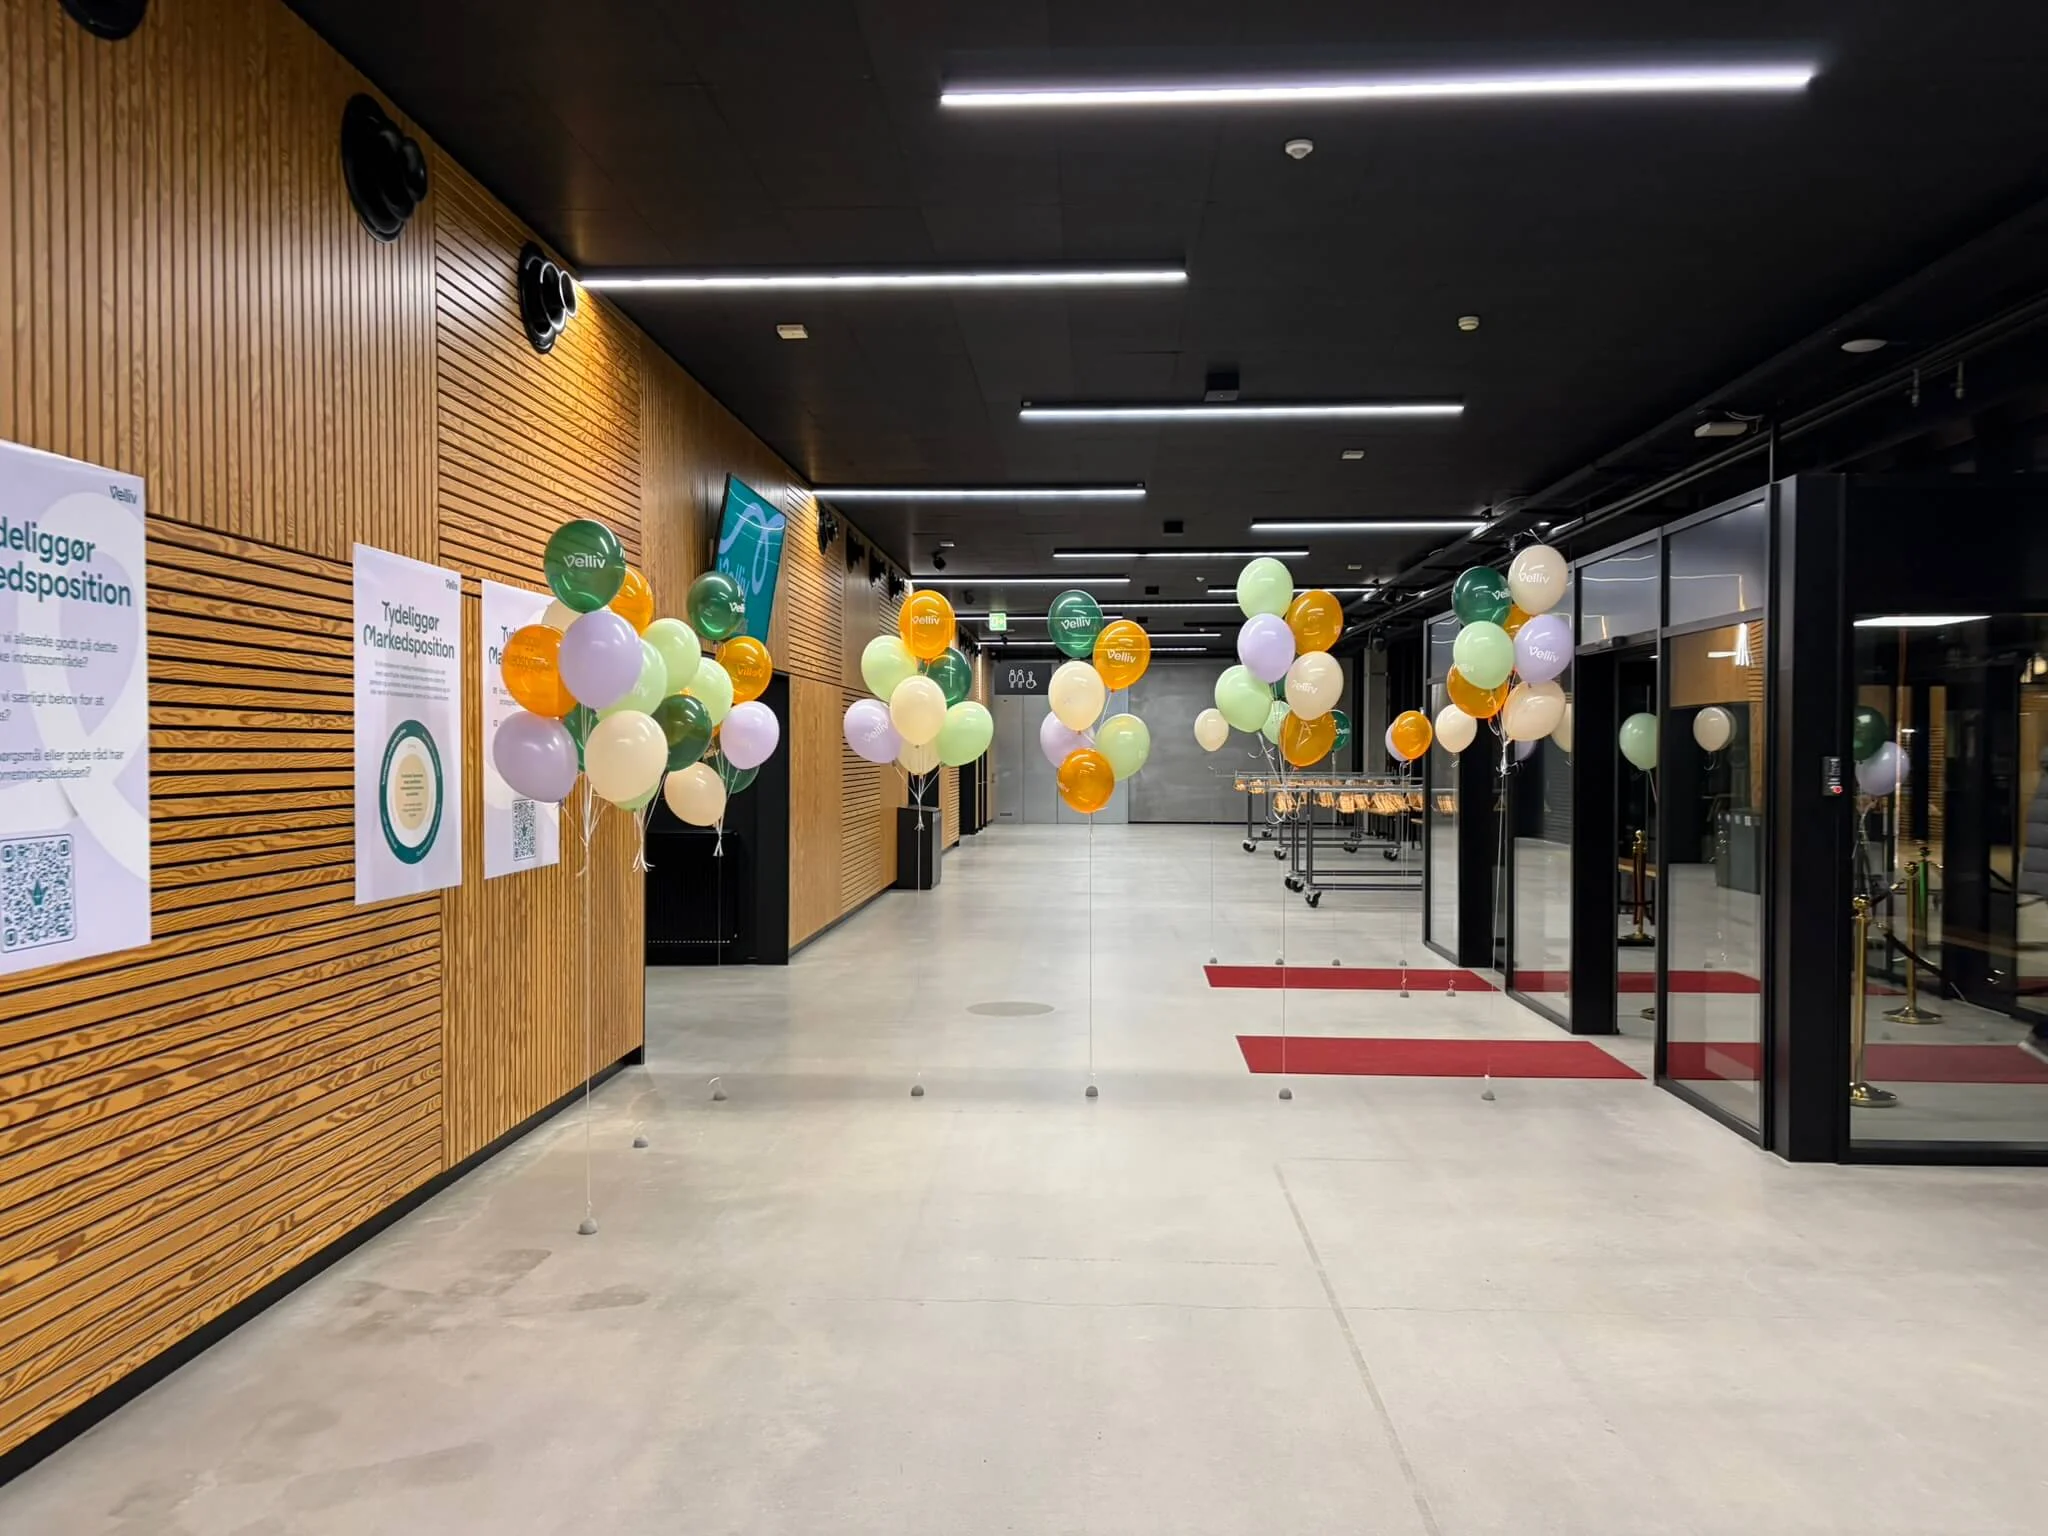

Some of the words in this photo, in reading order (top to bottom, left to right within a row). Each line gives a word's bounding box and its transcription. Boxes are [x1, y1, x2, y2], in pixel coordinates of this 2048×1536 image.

[563, 554, 606, 568] Velliv
[1519, 572, 1550, 585] Velliv
[382, 600, 439, 634] Tydeliggør
[911, 615, 940, 625] Velliv
[1061, 617, 1091, 630] Velliv
[363, 624, 455, 659] Markedsposition
[1106, 649, 1136, 664] Velliv
[1529, 645, 1559, 662] Velliv
